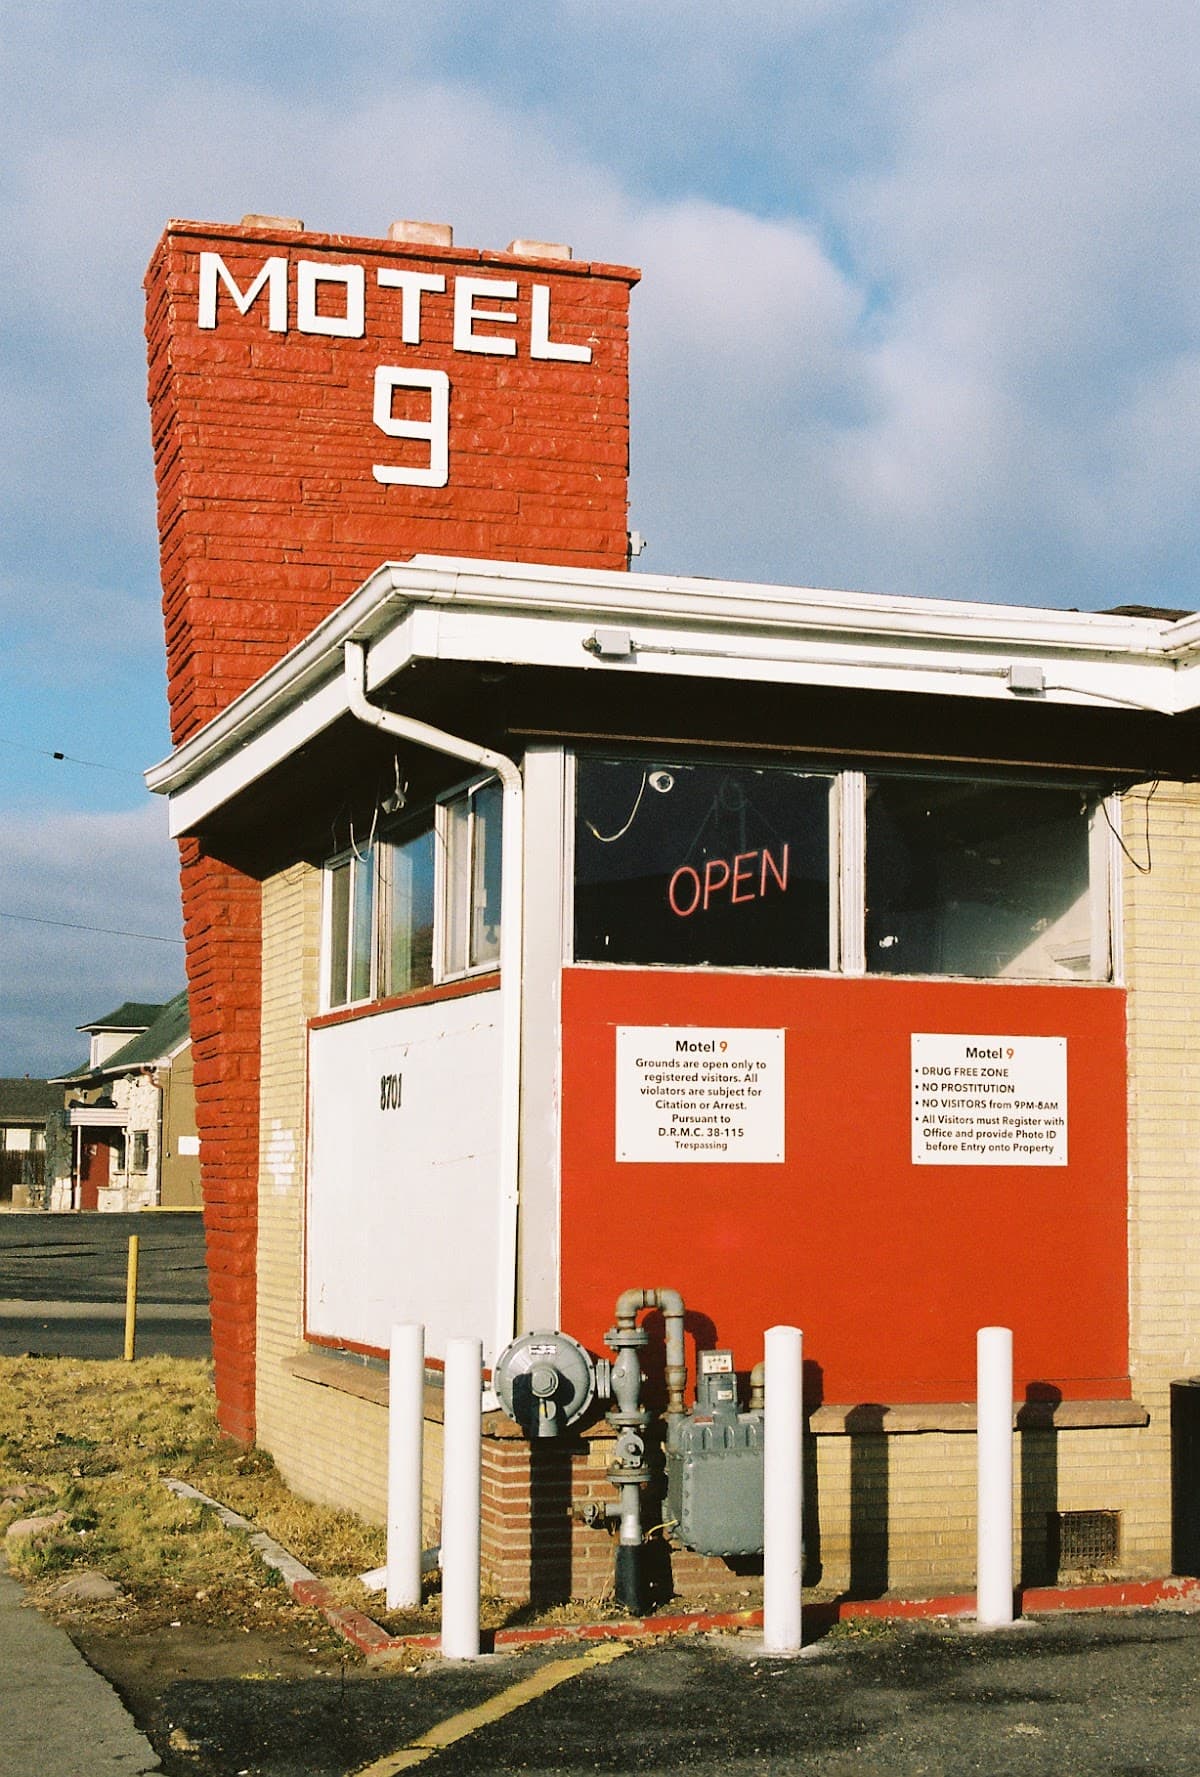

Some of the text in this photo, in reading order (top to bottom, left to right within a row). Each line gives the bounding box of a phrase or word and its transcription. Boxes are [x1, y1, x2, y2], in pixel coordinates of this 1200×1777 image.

[198, 251, 592, 363] MOTEL
[372, 365, 450, 488] 9
[669, 843, 789, 916] OPEN
[676, 1040, 728, 1052] Motel 9
[966, 1047, 1014, 1059] Motel 9
[636, 1058, 680, 1068] Grounds
[702, 1062, 728, 1071] open
[731, 1060, 753, 1071] only
[756, 1061, 766, 1069] to
[645, 1072, 757, 1084] registered visitors. All
[922, 1067, 1008, 1077] DRUG FREE ZONE
[381, 1073, 402, 1111] 8701
[640, 1086, 685, 1095] violators
[708, 1087, 744, 1098] subject
[747, 1087, 762, 1096] for
[922, 1083, 1015, 1093] NO PROSTITUTION
[656, 1100, 696, 1109] Citation
[713, 1101, 746, 1110] Arrest.
[922, 1099, 1058, 1110] NO VISITORS from 9PM-8AM
[672, 1114, 717, 1123] Pursuant
[922, 1115, 1064, 1127] All Visitors must Register with
[658, 1128, 744, 1137] D.R.M.C. 38-115
[923, 1128, 1056, 1140] Office and provide Photo ID
[675, 1141, 727, 1151] Trespassing
[926, 1141, 958, 1151] before
[961, 1142, 986, 1154] Entry
[1013, 1143, 1054, 1154] Property
